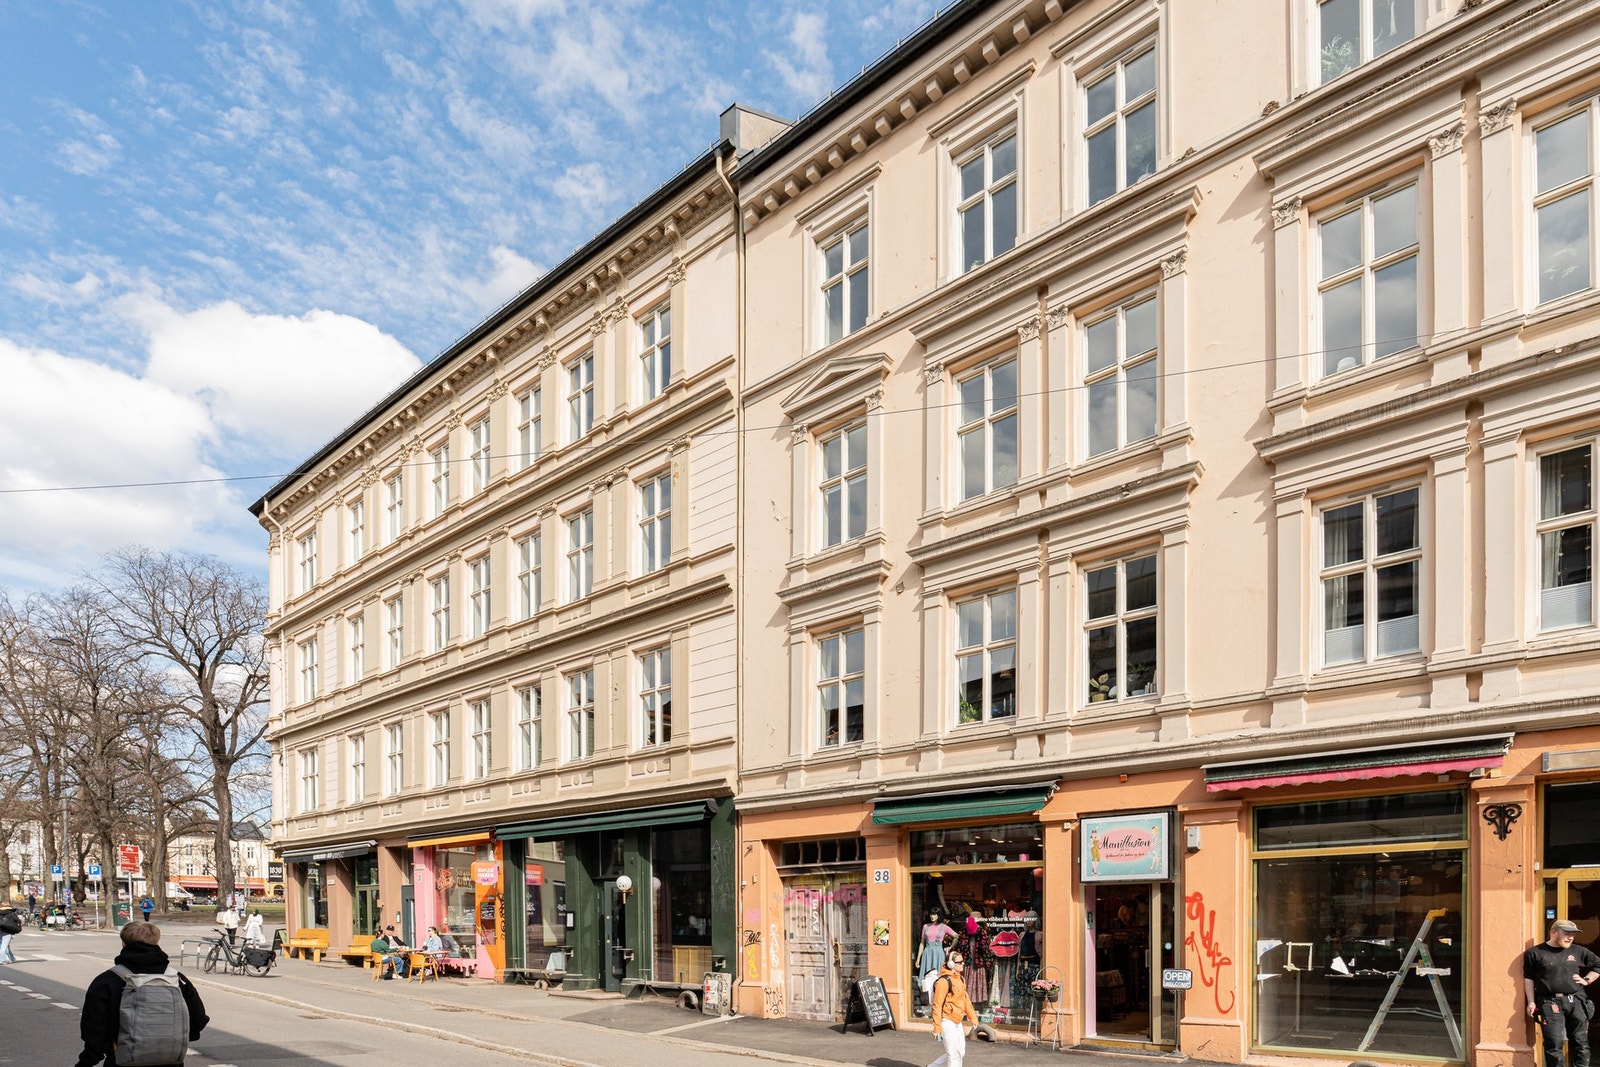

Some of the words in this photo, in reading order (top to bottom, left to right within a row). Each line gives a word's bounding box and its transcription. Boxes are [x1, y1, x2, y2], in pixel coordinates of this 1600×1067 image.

[1098, 834, 1151, 850] Manillusion
[874, 870, 890, 882] 38
[1165, 971, 1189, 981] OPEN
